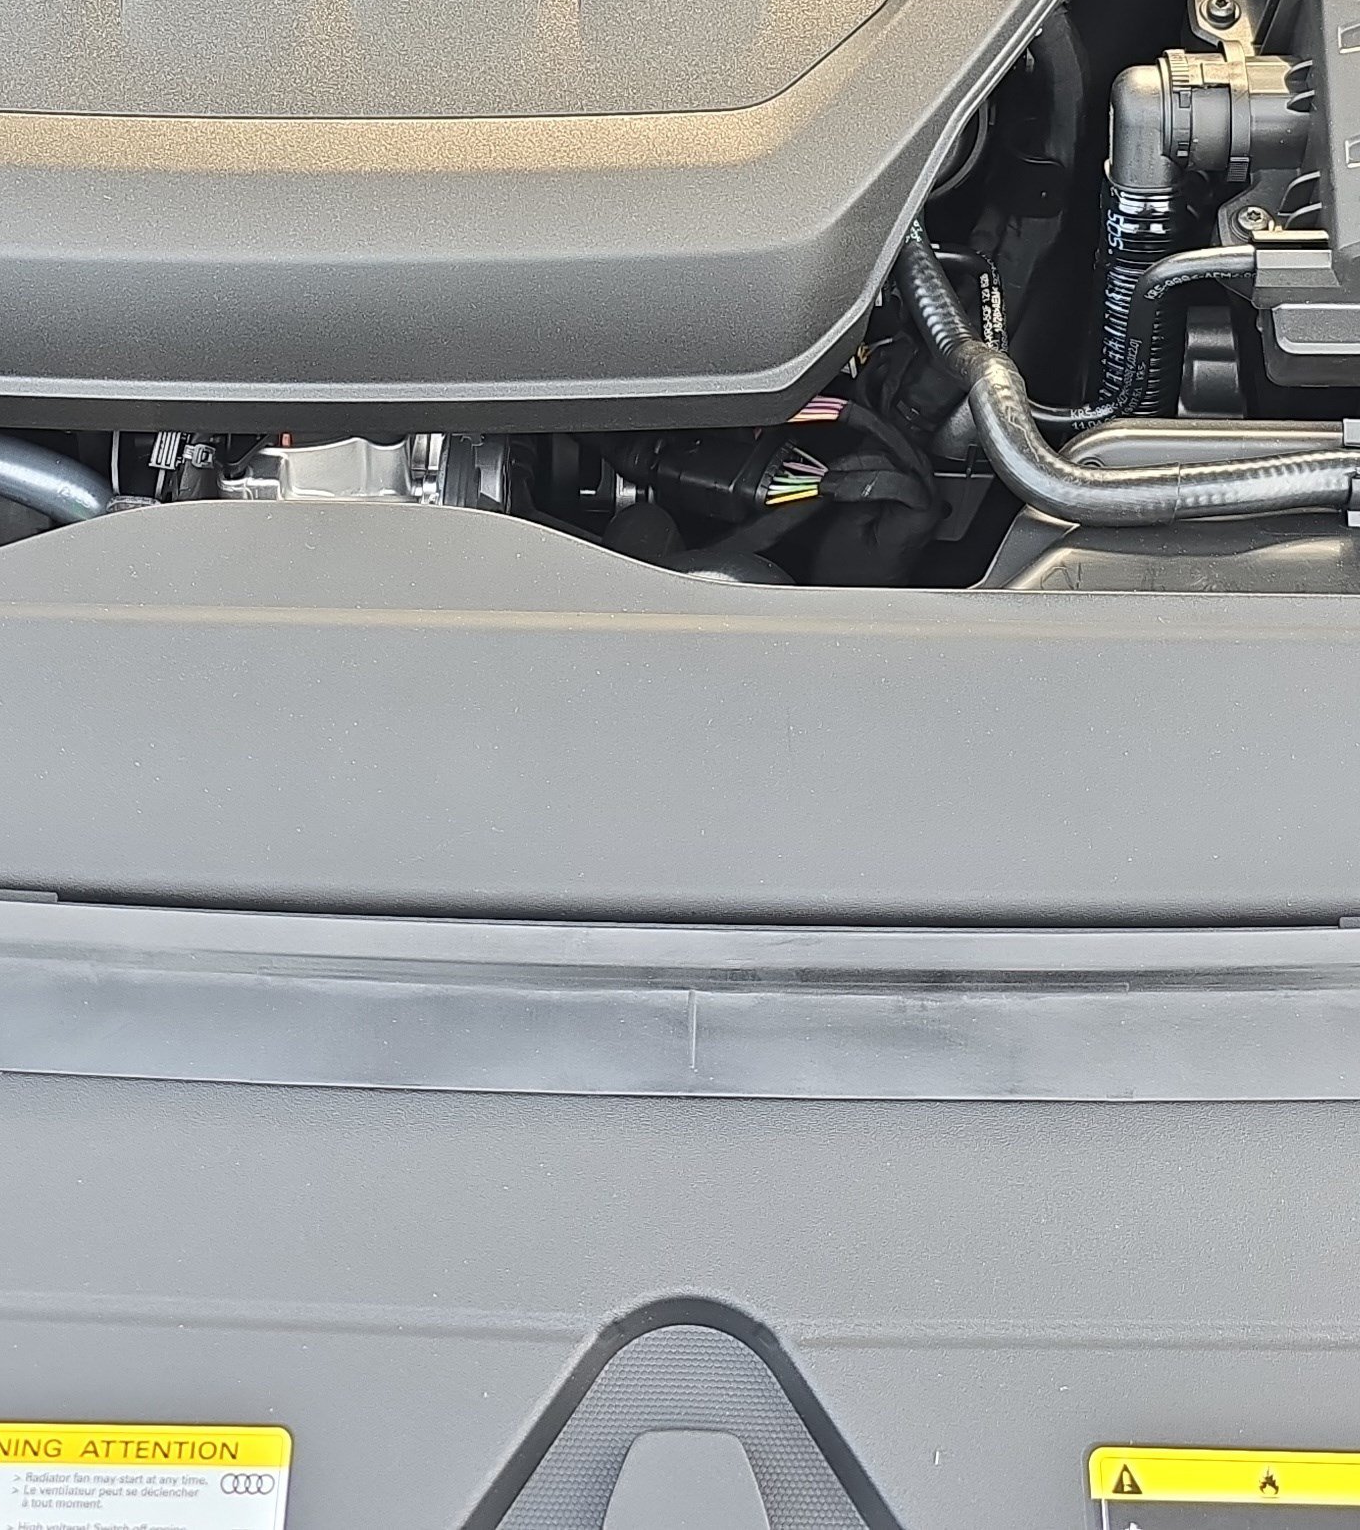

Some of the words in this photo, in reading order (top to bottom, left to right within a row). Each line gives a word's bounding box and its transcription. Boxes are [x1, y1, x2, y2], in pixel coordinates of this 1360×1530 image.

[78, 1438, 240, 1462] ATTENTION
[25, 1471, 70, 1484] Radiator
[72, 1473, 91, 1484] fan
[93, 1475, 115, 1486] may
[118, 1474, 143, 1485] start
[146, 1475, 158, 1485] at
[159, 1477, 178, 1487] any
[181, 1475, 209, 1486] time.
[23, 1485, 36, 1496] Le
[40, 1485, 95, 1496] ventilateur
[98, 1487, 123, 1499] peut
[126, 1489, 138, 1497] se
[30, 1498, 54, 1508] tout
[56, 1499, 103, 1509] moment.
